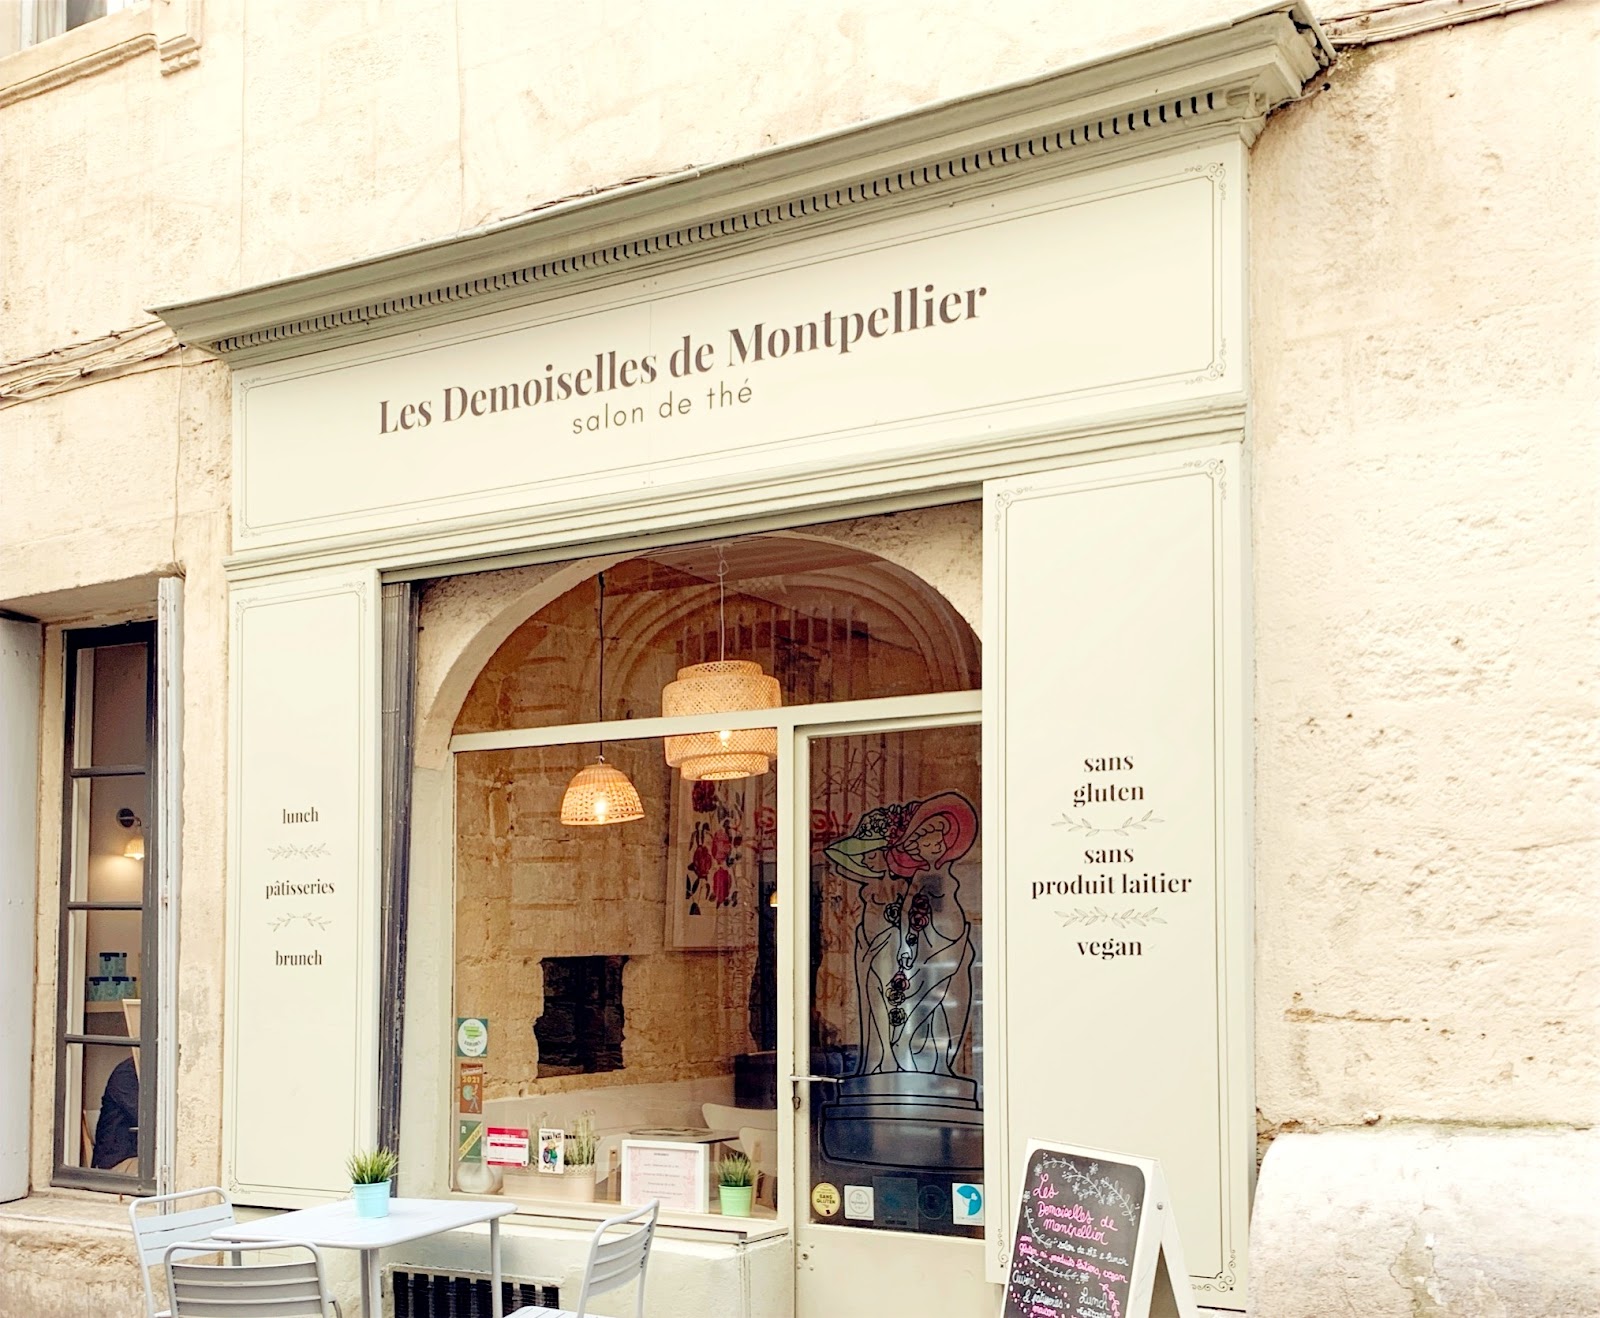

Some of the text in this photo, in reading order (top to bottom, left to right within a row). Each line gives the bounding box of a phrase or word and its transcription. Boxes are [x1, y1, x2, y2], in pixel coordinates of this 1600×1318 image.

[379, 283, 988, 435] Les Demoiselles de Montpellier
[572, 378, 753, 435] salon de thé
[1083, 755, 1134, 773] sans
[1073, 782, 1145, 808] gluten
[282, 806, 319, 824] lunch
[1083, 847, 1134, 864] sans
[265, 878, 335, 900] pâtisseries
[1032, 872, 1192, 900] produit laitier
[275, 949, 322, 967] brunch
[1077, 938, 1143, 961] vegan
[462, 1075, 480, 1084] 2021
[1033, 1173, 1059, 1199] Les
[1037, 1201, 1119, 1232] Demoiselles de
